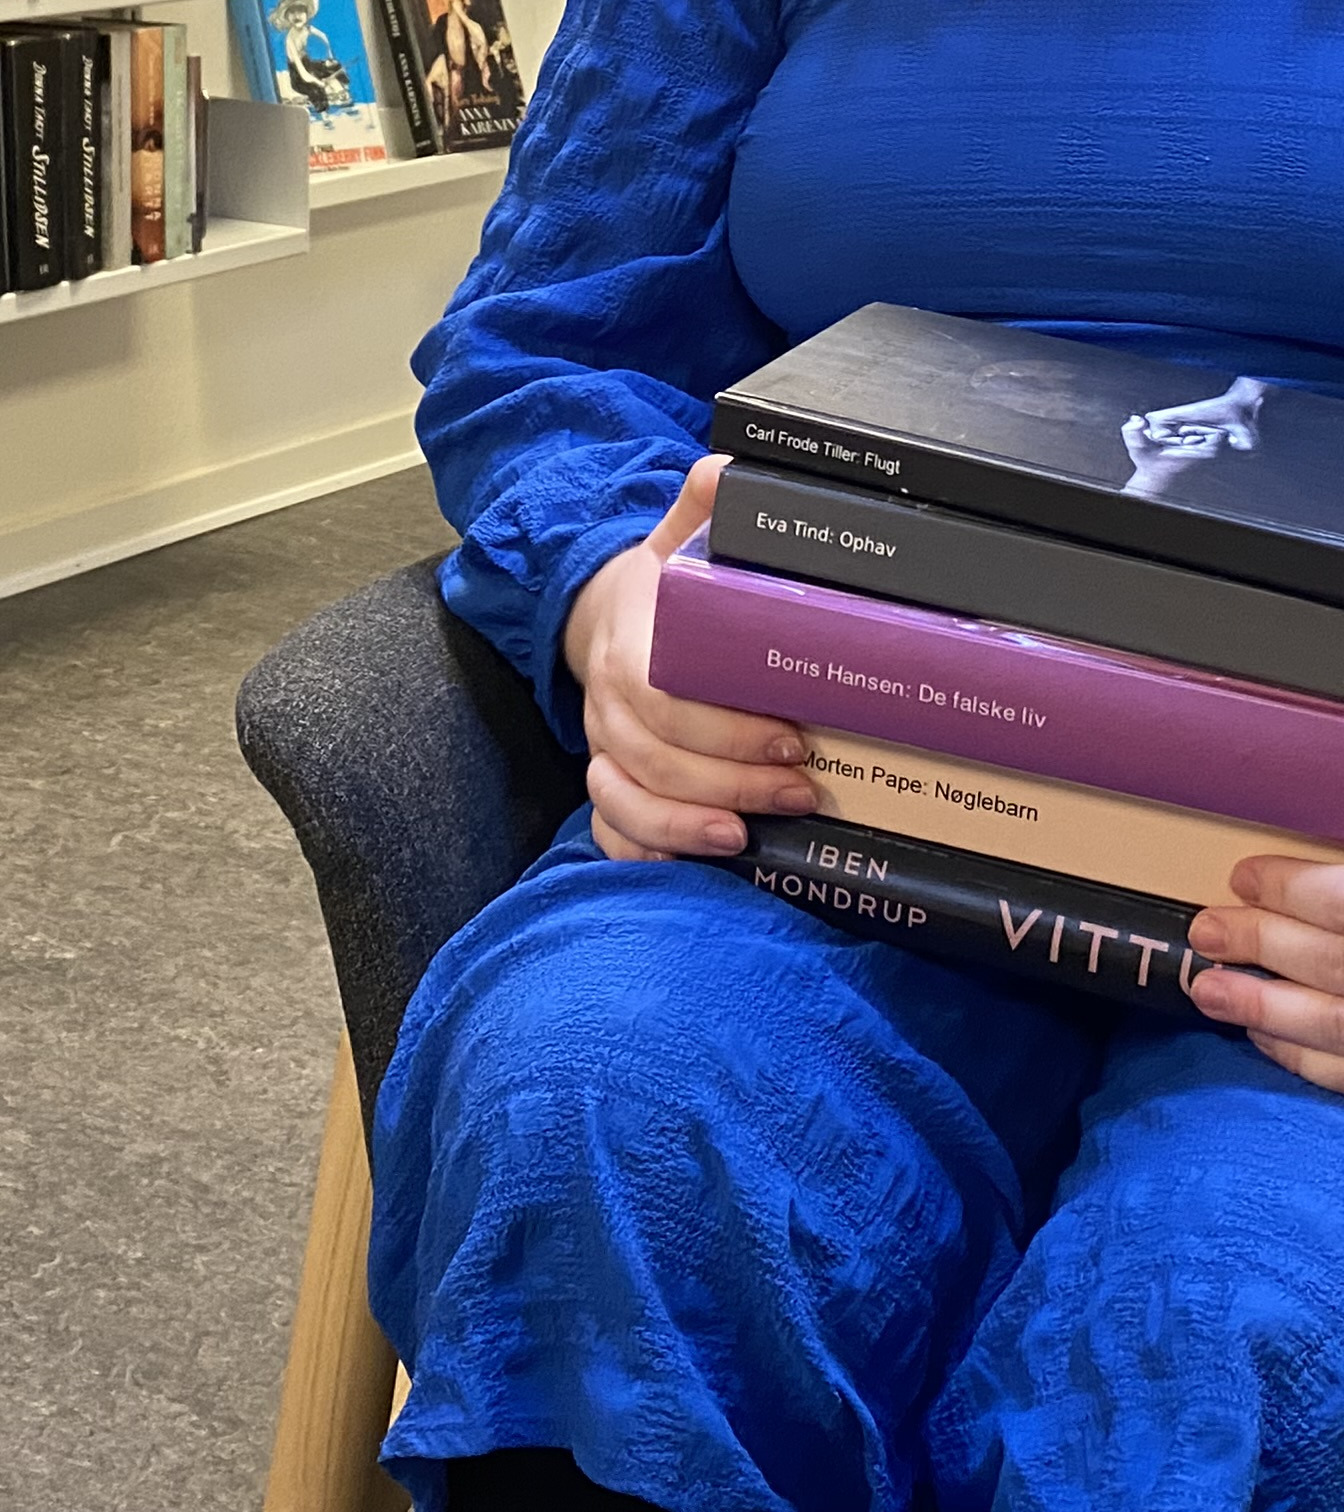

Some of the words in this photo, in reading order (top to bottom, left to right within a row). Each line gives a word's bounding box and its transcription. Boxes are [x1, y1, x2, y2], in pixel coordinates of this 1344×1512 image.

[31, 145, 50, 249] STILLIDSEN
[82, 137, 96, 239] STILLIDSEN
[746, 423, 774, 442] Carl
[778, 431, 818, 453] Frode
[824, 442, 860, 462] Tiller:
[864, 452, 900, 475] Flugt
[757, 513, 786, 533] Eva
[793, 518, 833, 544] Tind:
[840, 531, 896, 557] Ophav
[767, 649, 820, 677] Boris
[827, 662, 911, 697] Hansen:
[919, 683, 946, 706] De
[953, 690, 1015, 723] falske
[1023, 706, 1046, 728] liv
[872, 765, 928, 796] Pape:
[935, 780, 1039, 822] Nøglebarn
[805, 841, 889, 882] IBEN
[754, 867, 927, 928] MONDRUP
